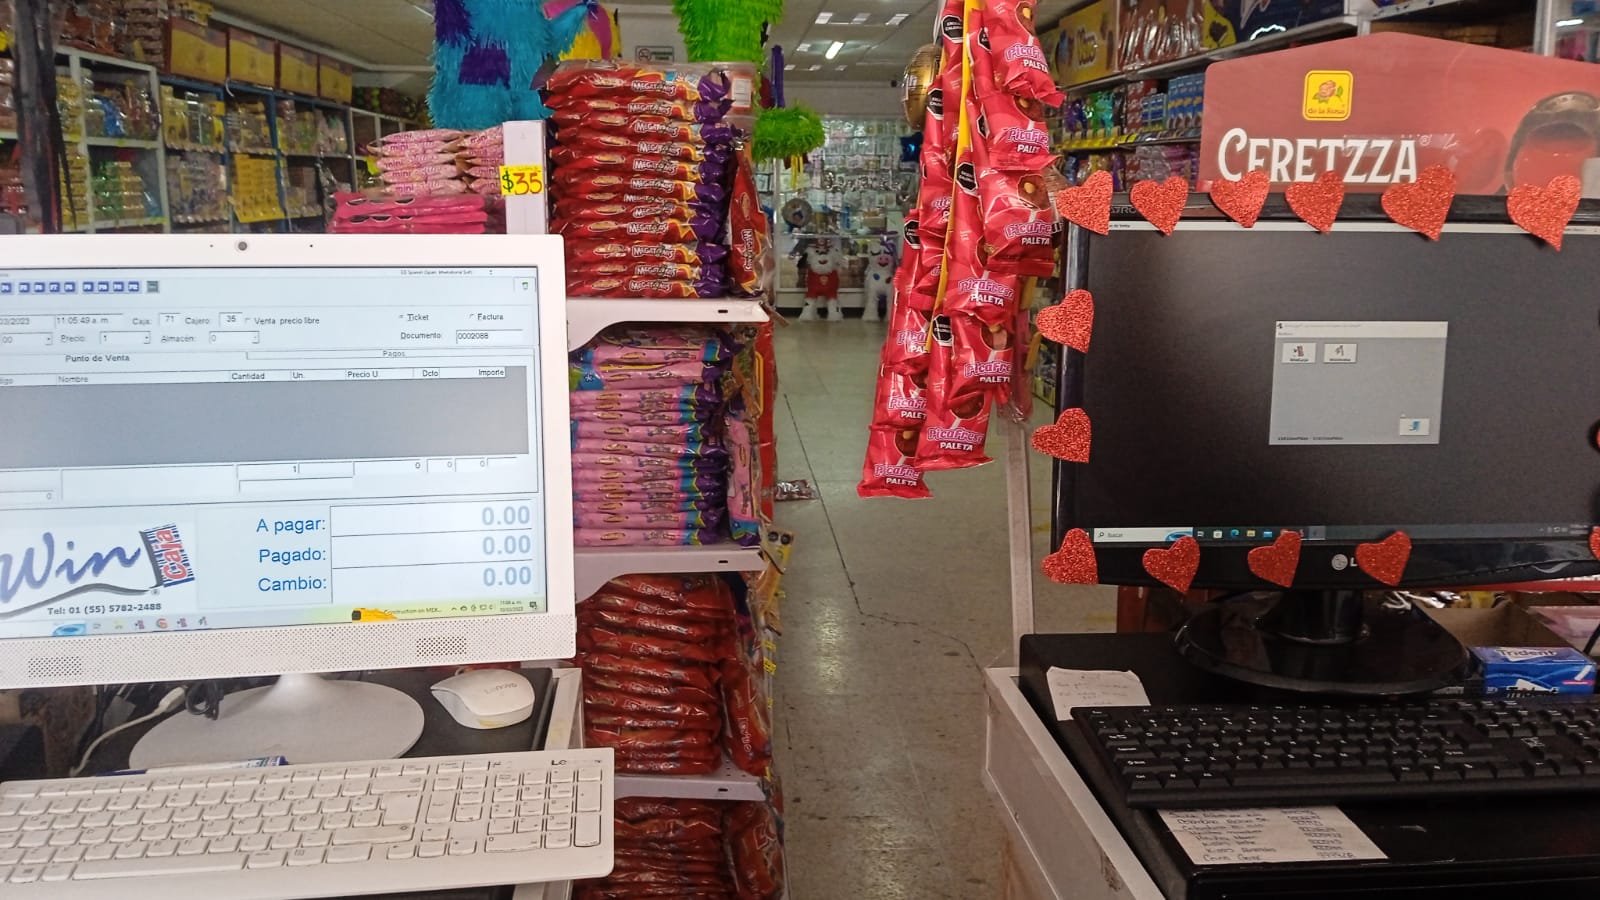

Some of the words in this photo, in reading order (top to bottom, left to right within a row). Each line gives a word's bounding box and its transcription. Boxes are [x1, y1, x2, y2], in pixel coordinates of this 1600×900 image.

[1218, 128, 1417, 183] CERETZZA
[502, 170, 542, 195] $35
[1021, 237, 1050, 246] PALETA
[970, 293, 1004, 306] PALETA
[255, 317, 275, 325] Venta
[280, 317, 302, 326] precio
[304, 316, 320, 325] libre
[407, 313, 429, 321] Ticket
[477, 313, 504, 321] Factura
[400, 332, 442, 340] Documento:
[65, 354, 90, 363] Punto
[92, 354, 103, 362] de
[106, 353, 130, 362] Venta
[383, 350, 405, 359] Pagos
[231, 371, 265, 380] Cantidad
[347, 370, 370, 378] Precio
[422, 369, 439, 377] Dcto
[478, 368, 504, 377] Importe
[58, 374, 88, 383] Nombre
[940, 442, 973, 451] PALETA
[886, 477, 917, 487] PALETA
[481, 506, 530, 526] 0.00
[256, 519, 268, 533] A
[274, 517, 325, 535] pagar:
[482, 535, 531, 555] 0.00
[156, 528, 188, 580] Caja
[259, 548, 326, 565] Pagado:
[483, 566, 532, 586] 0.00
[258, 575, 327, 592] Cambio:
[48, 607, 66, 616] Tel:
[68, 606, 81, 614] 01
[84, 605, 106, 615] (55)
[109, 602, 162, 613] 5782-2488
[1500, 649, 1556, 657] Trident
